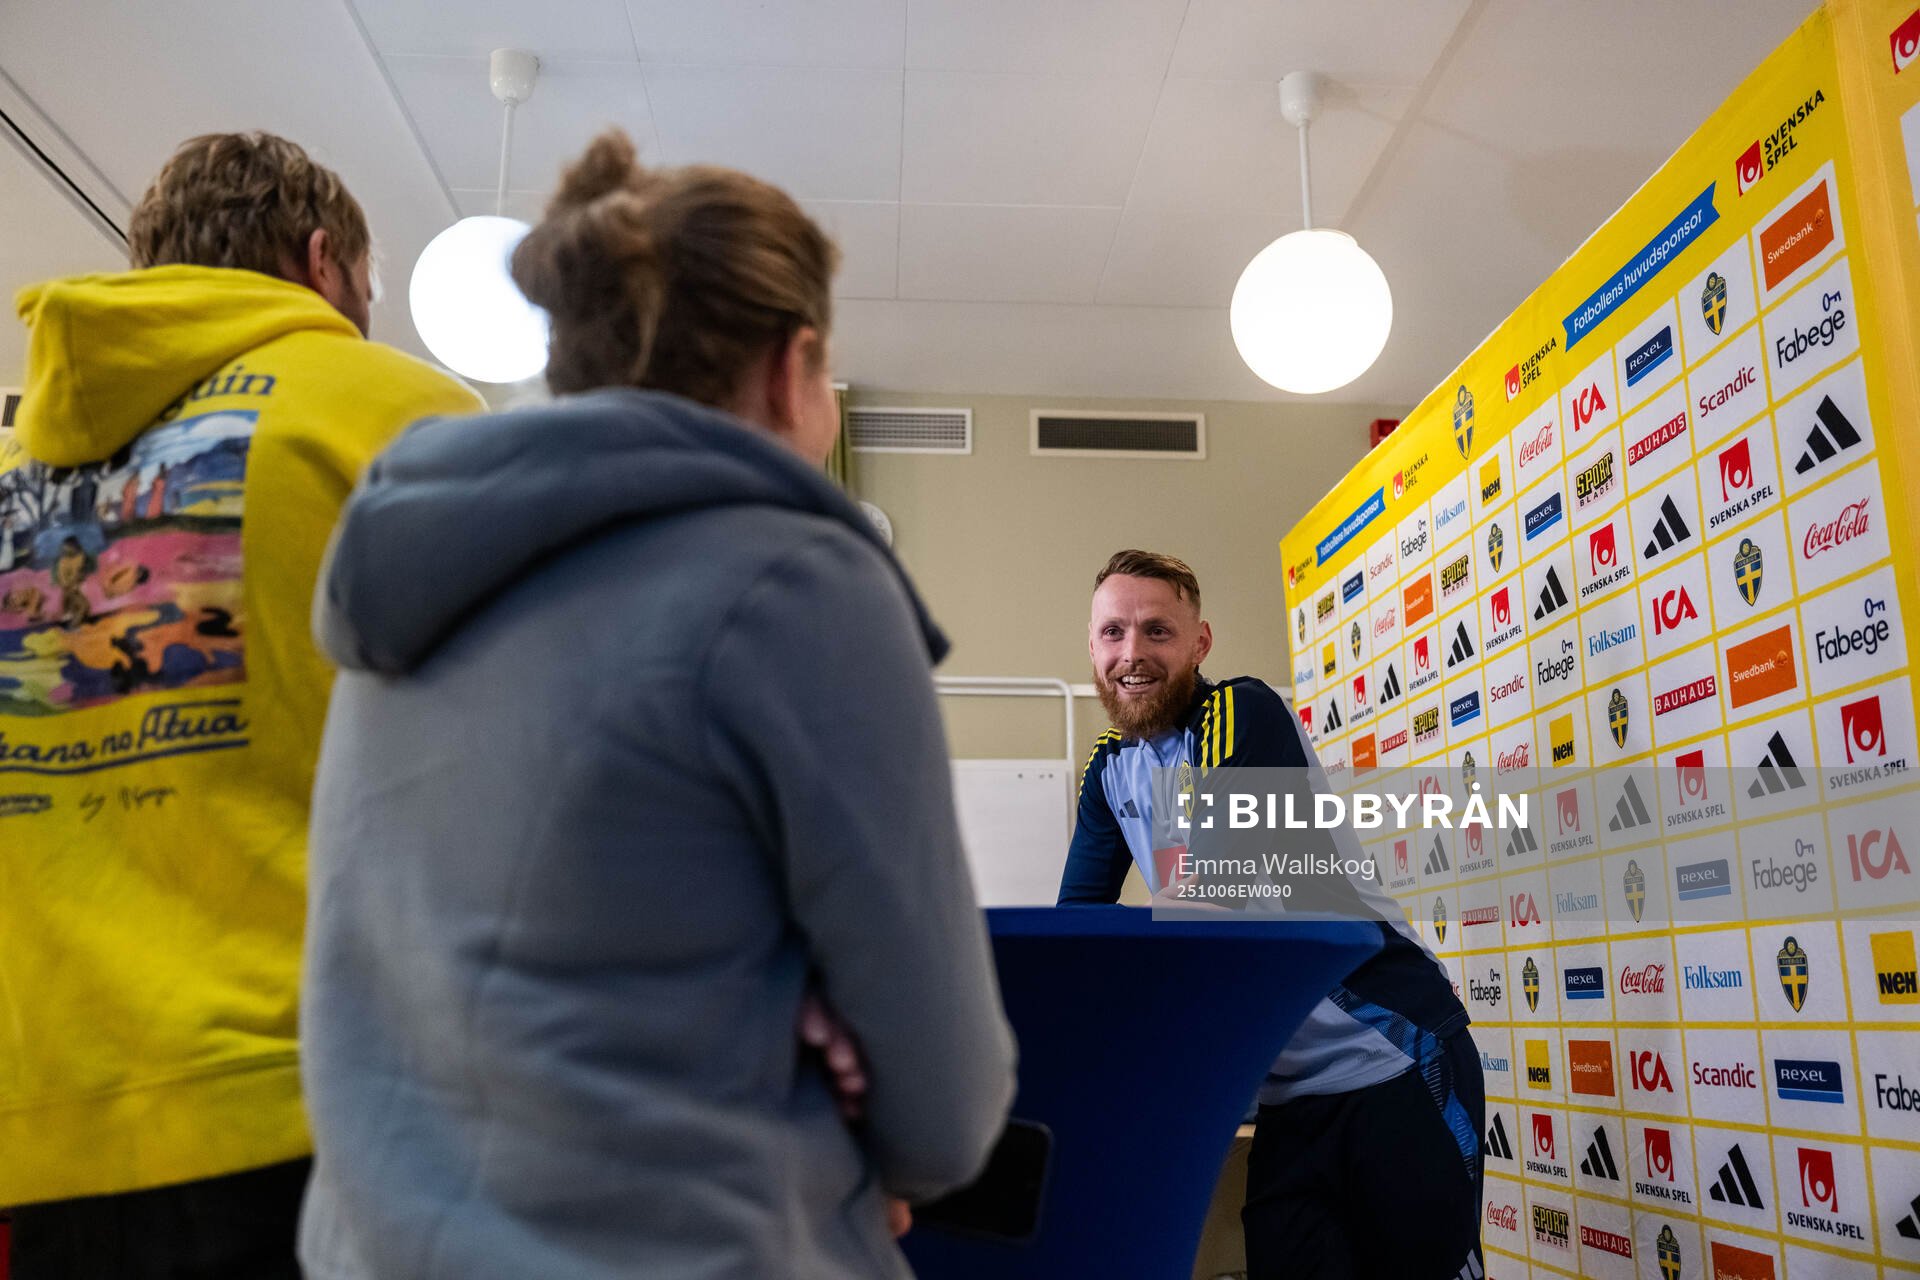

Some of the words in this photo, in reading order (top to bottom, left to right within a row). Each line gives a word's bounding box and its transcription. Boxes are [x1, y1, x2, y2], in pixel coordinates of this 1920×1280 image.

[1764, 89, 1825, 154] SVENSKA
[1767, 135, 1798, 171] SPEL
[1767, 222, 1813, 264] Swedbank
[1574, 281, 1623, 334] Fotbollens
[1624, 208, 1703, 290] huvudsponsor
[1776, 309, 1846, 369] Fabege
[1521, 337, 1557, 375] SVENSKA
[1522, 366, 1541, 389] SPEL
[1699, 366, 1756, 418] Scandic
[1572, 381, 1607, 432] ICA
[1519, 421, 1554, 468] Coca-Cola
[1629, 415, 1686, 463] BAUHAUS
[1404, 453, 1429, 480] SVENSKA
[1576, 453, 1613, 499] SPORT
[1405, 477, 1418, 493] SPEL
[1579, 478, 1615, 507] BLADET
[1435, 499, 1466, 532] Folksam
[1710, 498, 1750, 528] SVENSKA
[1751, 485, 1774, 506] SPEL
[1803, 495, 1871, 560] Coca-Cola
[1401, 531, 1427, 560] Fabege
[1370, 553, 1393, 581] Scandic
[1440, 555, 1469, 591] SPORT
[1581, 574, 1613, 598] SVENSKA
[1614, 565, 1631, 583] SPEL
[1653, 585, 1698, 636] ICA
[1486, 633, 1509, 651] SVENSKA
[1509, 624, 1522, 641] SPEL
[1589, 624, 1636, 657] Folksam
[1816, 619, 1889, 664] Fabege
[1409, 677, 1427, 692] SVENSKA
[1428, 670, 1438, 684] SPEL
[1538, 655, 1574, 686] Fabege
[1733, 659, 1775, 683] Swedbank
[1490, 674, 1525, 703] Scandic
[1655, 678, 1715, 713] BAUHAUS
[1413, 707, 1439, 738] SPORT
[1497, 741, 1529, 776] Coca-Cola
[1829, 766, 1882, 790] SVENSKA
[1883, 758, 1909, 777] SPEL
[1667, 809, 1704, 827] SVENSKA
[1705, 804, 1725, 818] SPEL
[1550, 838, 1577, 853] SVENSKA
[1578, 835, 1594, 847] SPEL
[1847, 826, 1911, 882] ICA
[1460, 860, 1480, 874] SVENSKA
[1482, 858, 1494, 868] SPEL
[1752, 857, 1818, 893] Fabege
[1462, 907, 1499, 924] BAUHAUS
[1509, 892, 1541, 928] ICA
[1556, 892, 1598, 915] Folksam
[1469, 979, 1502, 1006] Fabege
[1620, 964, 1666, 995] Coca-Cola
[1684, 965, 1742, 989] Folksam
[1479, 1053, 1509, 1072] olksam
[1572, 1061, 1602, 1073] Swedbank
[1630, 1050, 1674, 1093] ICA
[1693, 1062, 1756, 1089] Scandic
[1526, 1160, 1551, 1175] SVENSKA
[1553, 1165, 1568, 1178] SPEL
[1635, 1182, 1671, 1201] SVENSKA
[1672, 1190, 1692, 1203] SPEL
[1486, 1200, 1518, 1232] Coca-Cola
[1533, 1205, 1569, 1240] SPORT
[1787, 1212, 1834, 1234] SVENSKA
[1836, 1223, 1865, 1240] SPEL
[1536, 1232, 1569, 1249] BLADET
[1582, 1228, 1631, 1254] BAUHAUS
